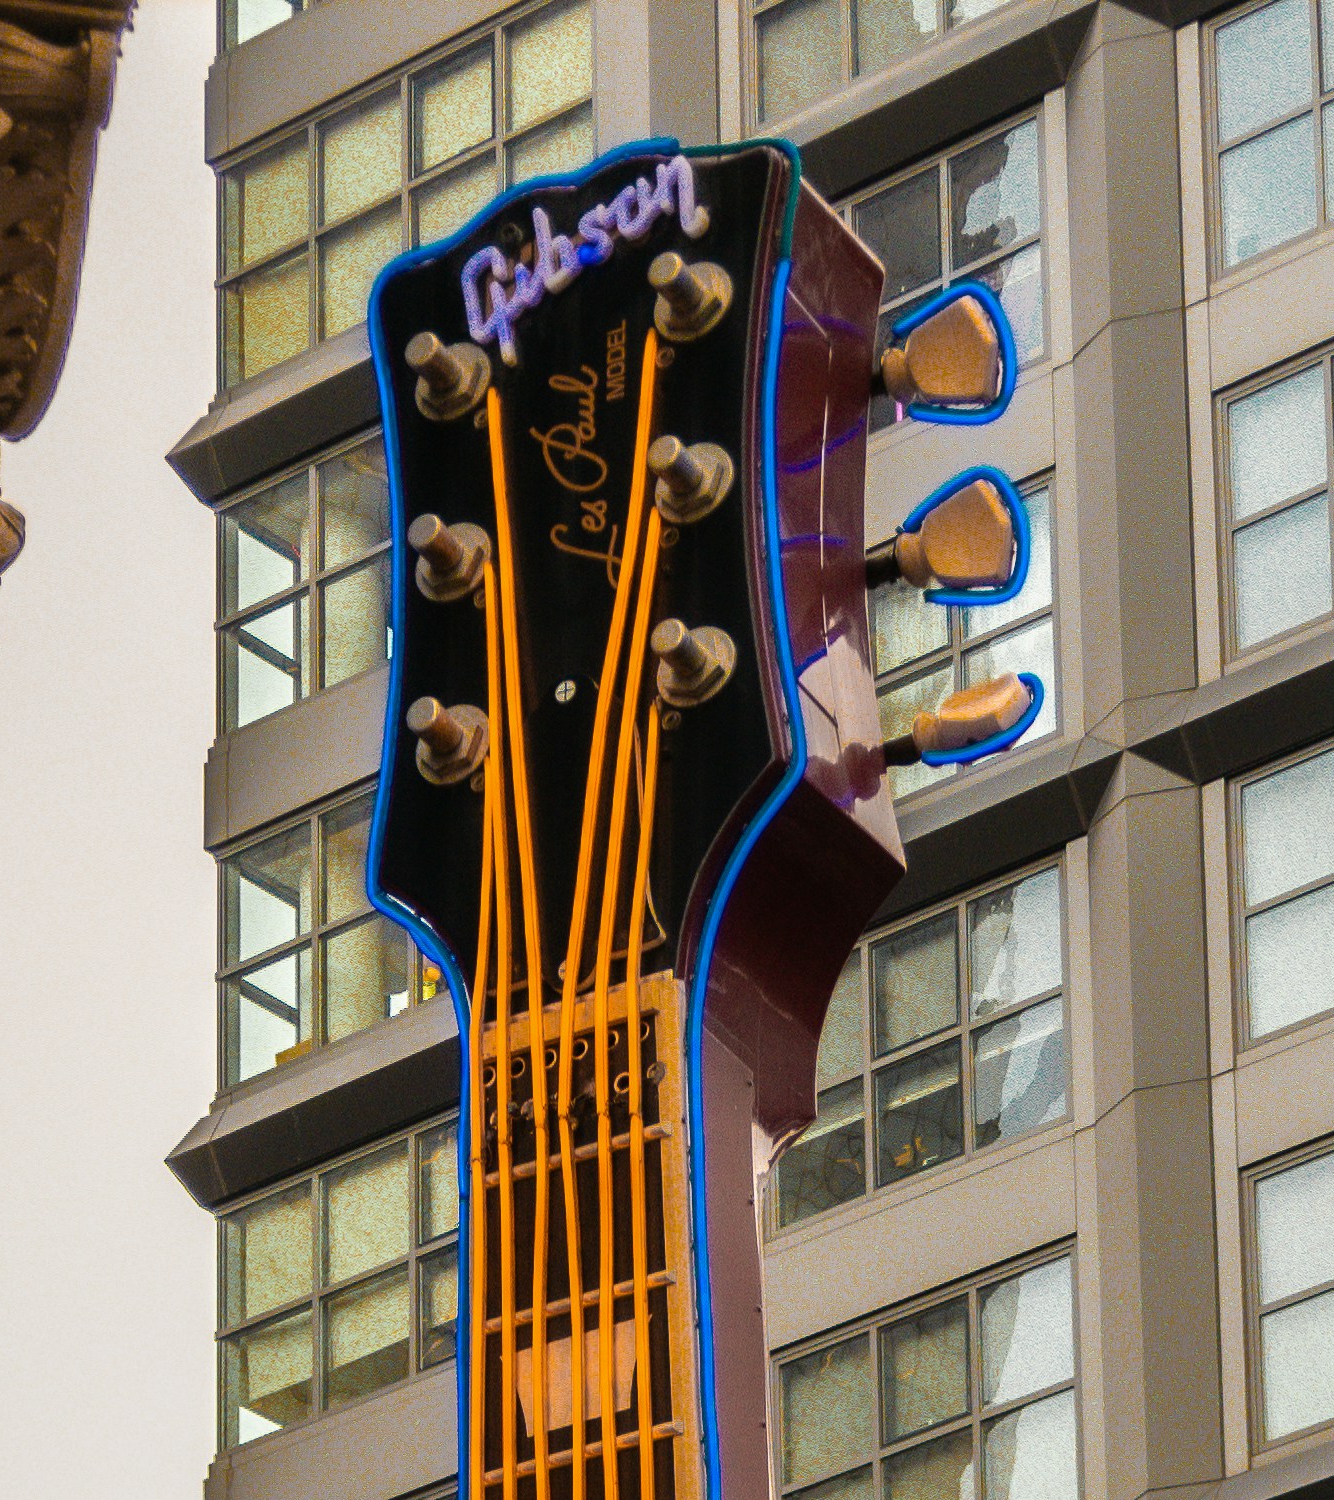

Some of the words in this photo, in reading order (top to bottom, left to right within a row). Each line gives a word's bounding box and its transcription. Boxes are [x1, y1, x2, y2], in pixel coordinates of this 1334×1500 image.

[461, 155, 710, 366] Gibson
[606, 318, 627, 401] MODEL
[529, 364, 608, 493] Paul
[550, 498, 623, 590] Les
